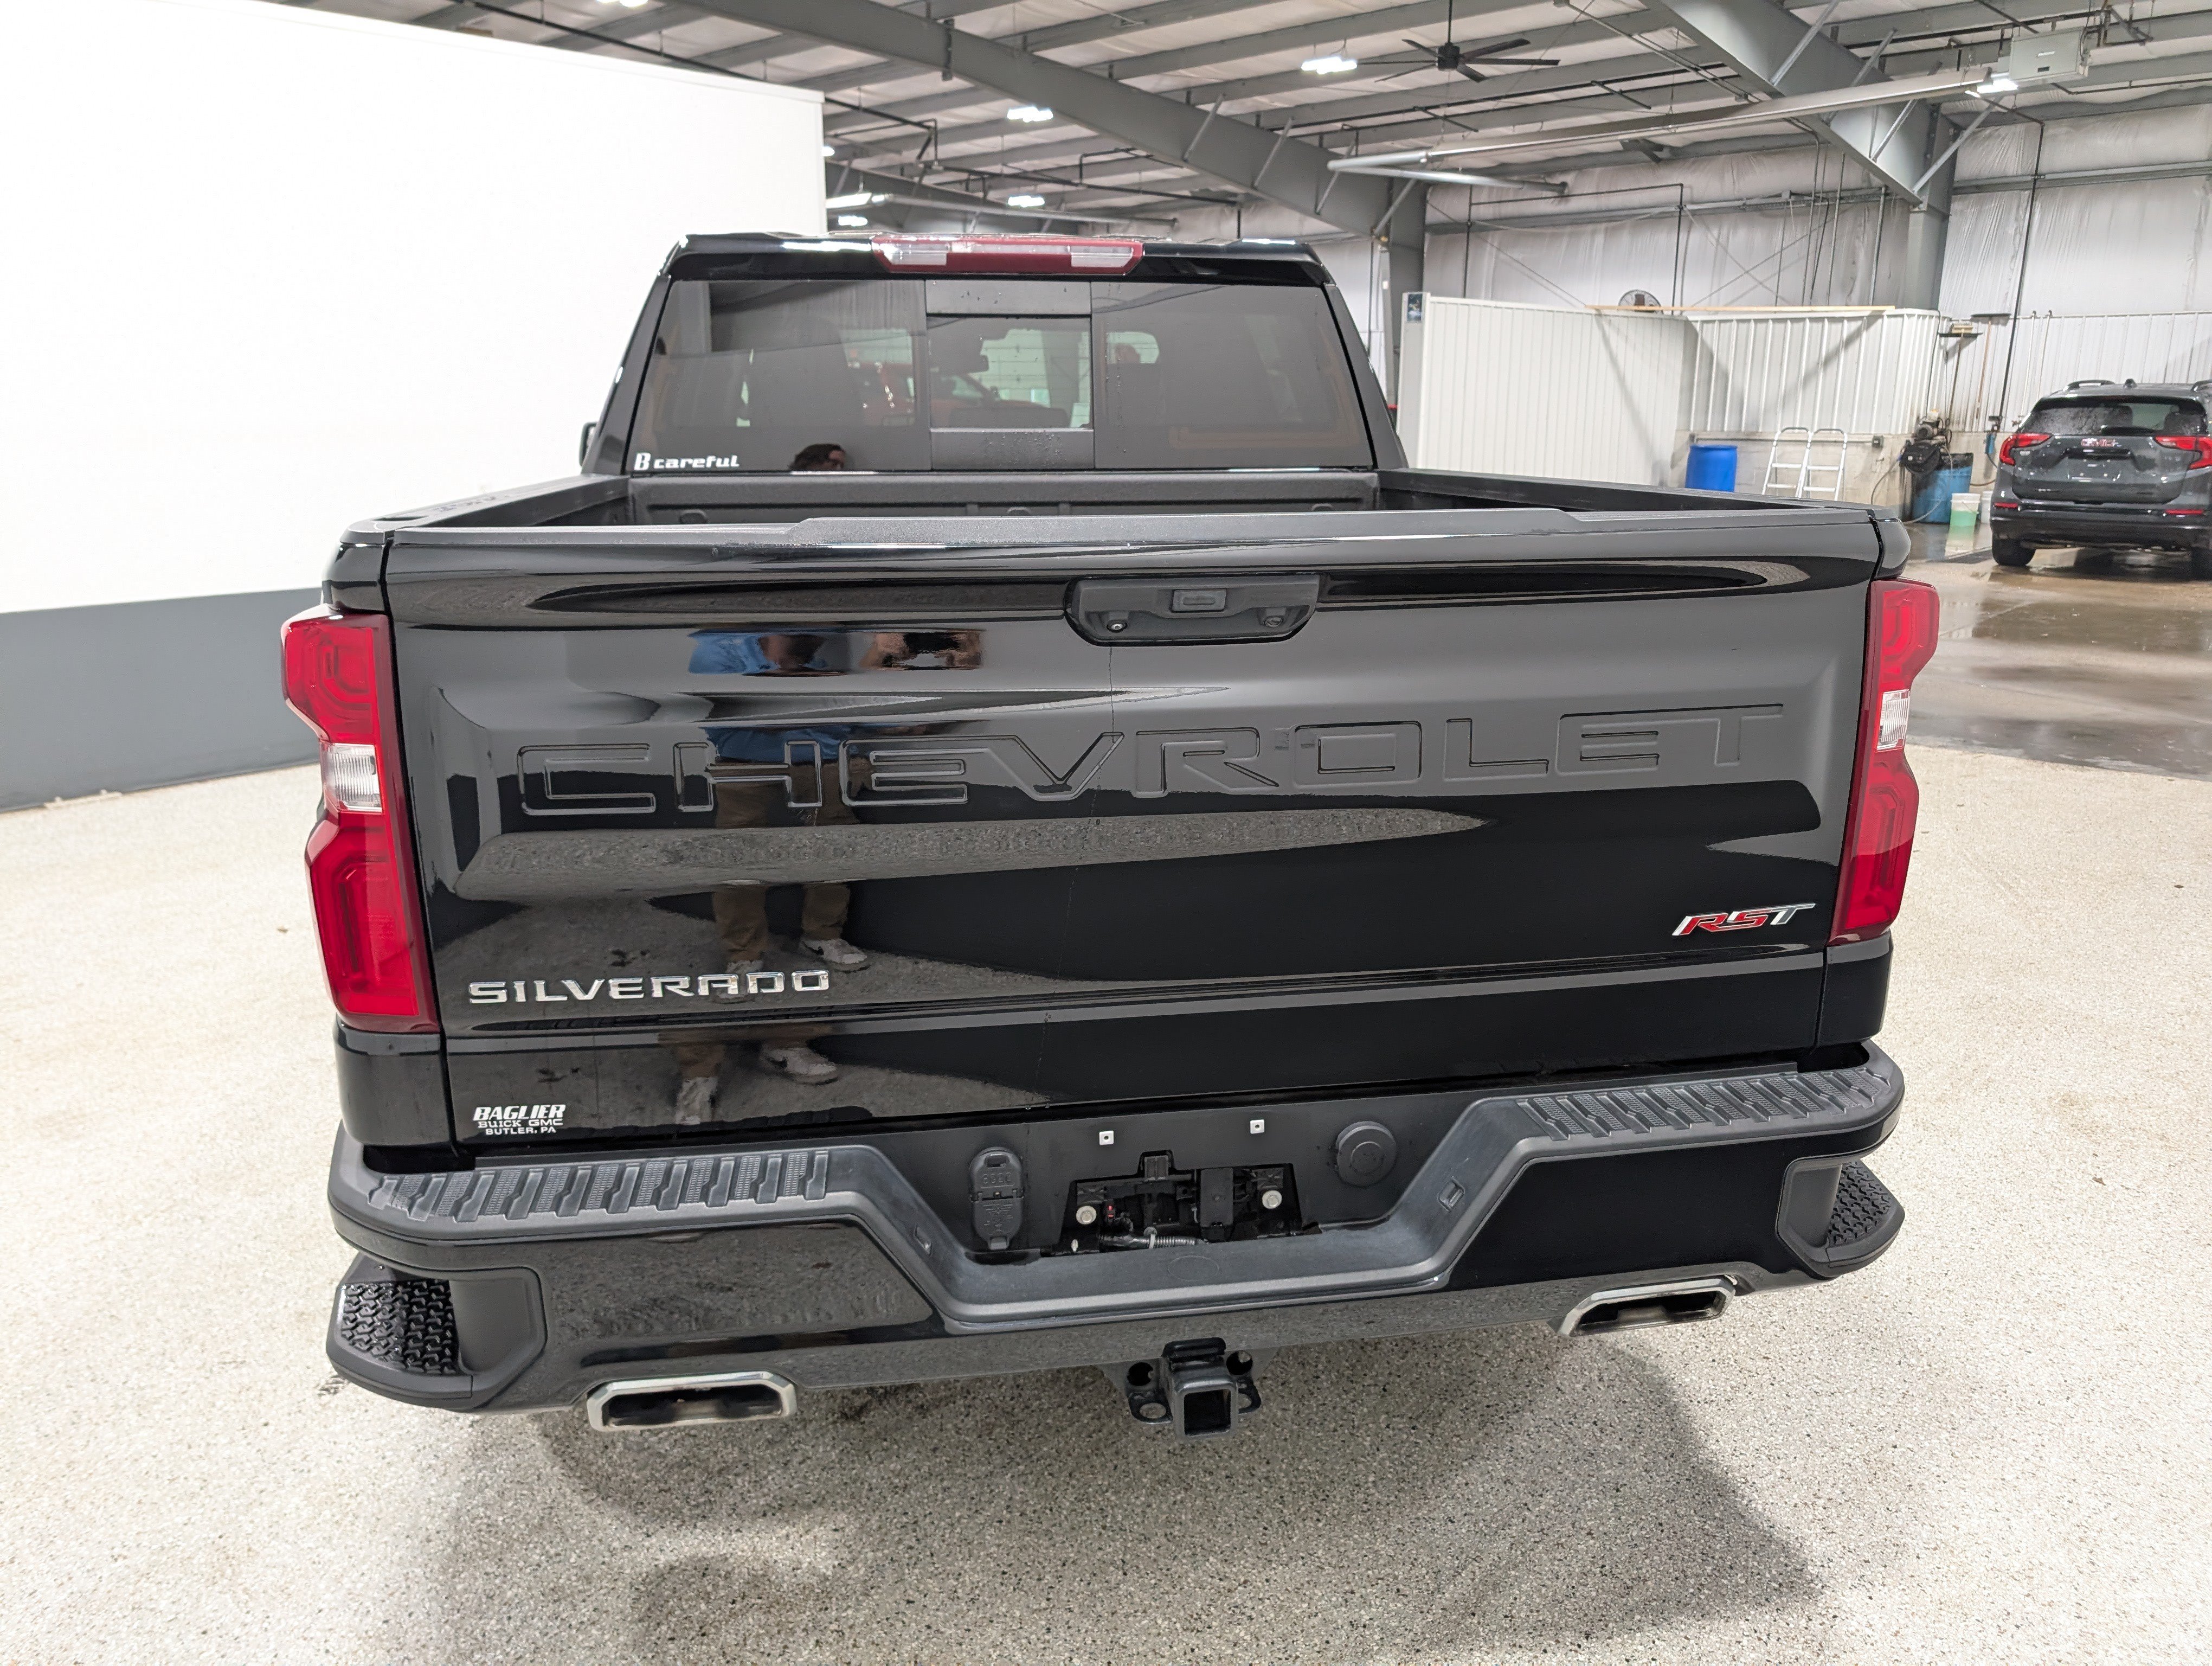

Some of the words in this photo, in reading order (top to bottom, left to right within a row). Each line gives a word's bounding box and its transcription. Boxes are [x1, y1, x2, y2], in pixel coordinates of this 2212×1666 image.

[634, 452, 651, 471] B
[653, 454, 740, 469] careful
[517, 704, 1784, 816] CHEVROLET
[1672, 903, 1816, 936] RST
[469, 970, 829, 1004] SILVERADO
[473, 1104, 566, 1121] BAGLIER
[528, 1118, 563, 1127] GMC
[541, 1126, 557, 1134] PA
